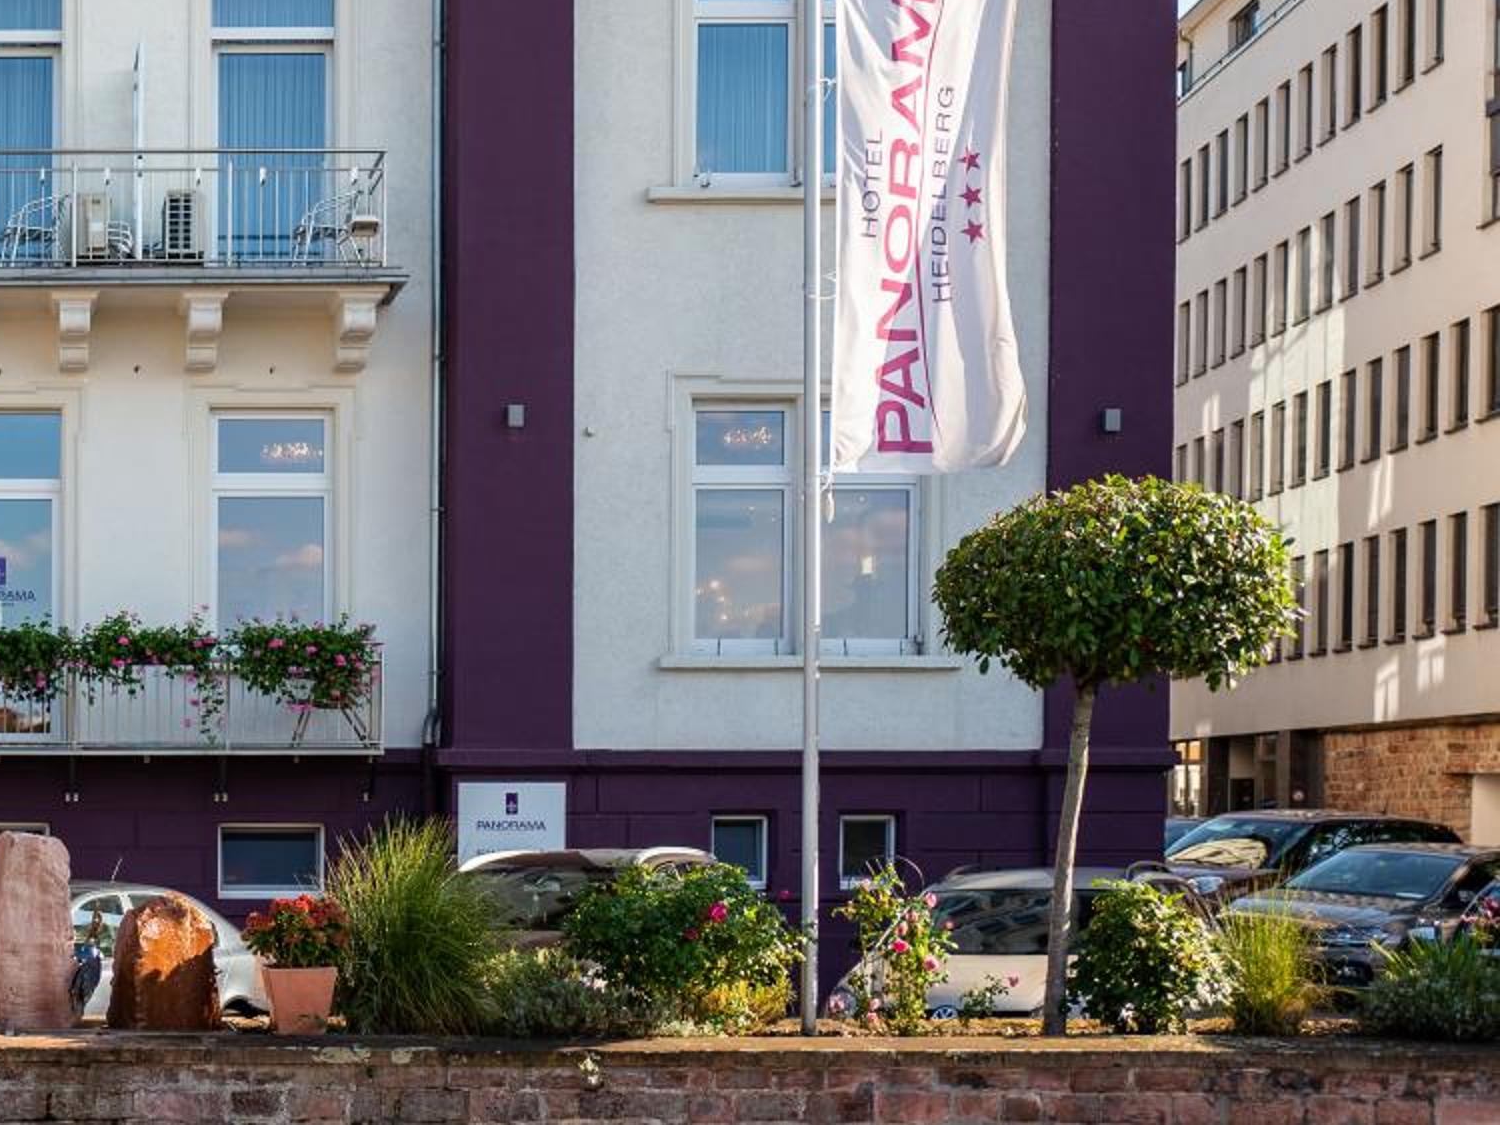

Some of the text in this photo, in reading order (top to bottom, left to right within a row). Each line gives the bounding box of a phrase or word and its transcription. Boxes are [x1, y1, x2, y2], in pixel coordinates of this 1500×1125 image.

[861, 129, 883, 239] HOTEL
[931, 85, 955, 304] HEIDELBERG
[476, 820, 547, 831] PANORAMA
